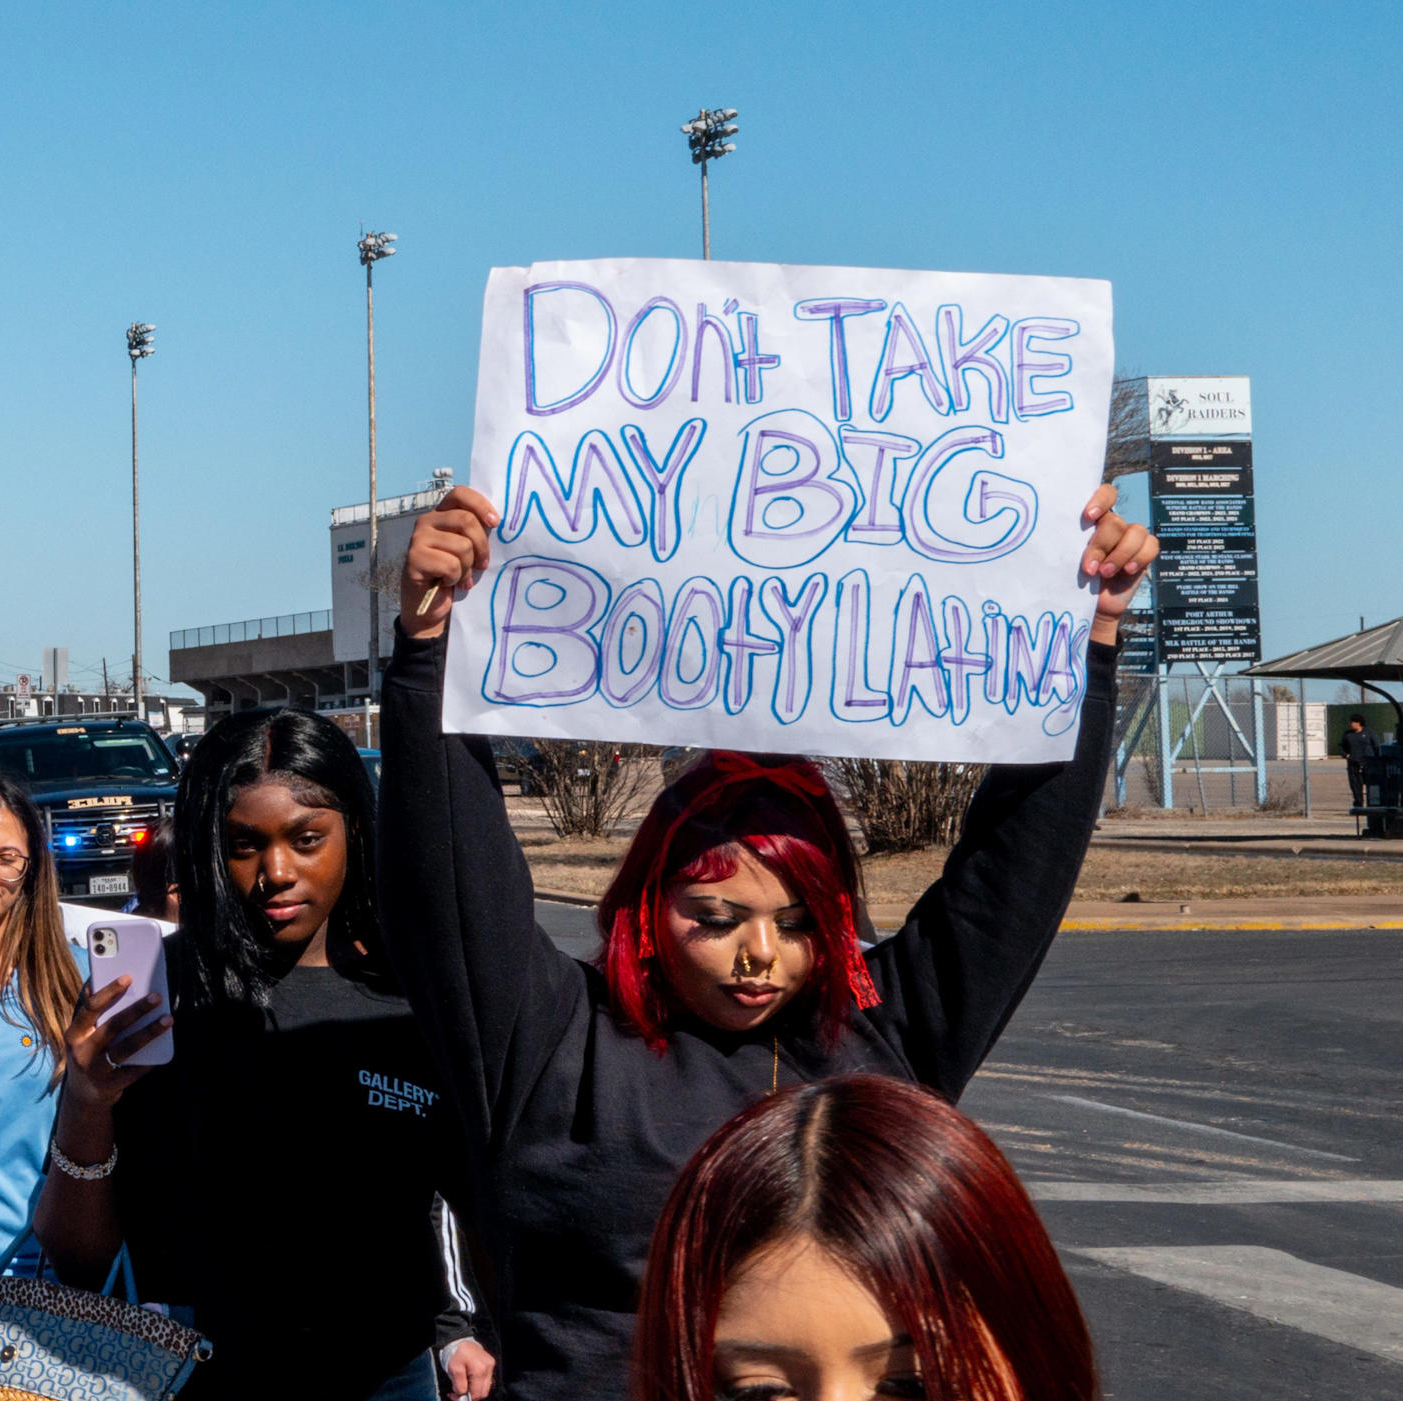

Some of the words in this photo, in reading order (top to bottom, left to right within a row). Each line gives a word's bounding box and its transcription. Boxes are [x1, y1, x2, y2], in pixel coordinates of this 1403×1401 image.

[793, 298, 1080, 424] TAKE
[1188, 408, 1246, 419] RAIDERS
[1199, 392, 1233, 403] SOUL
[498, 418, 707, 562] MY
[729, 409, 1038, 570] BIG
[358, 1069, 434, 1106] GALLERY
[368, 1089, 426, 1118] DEPT.
